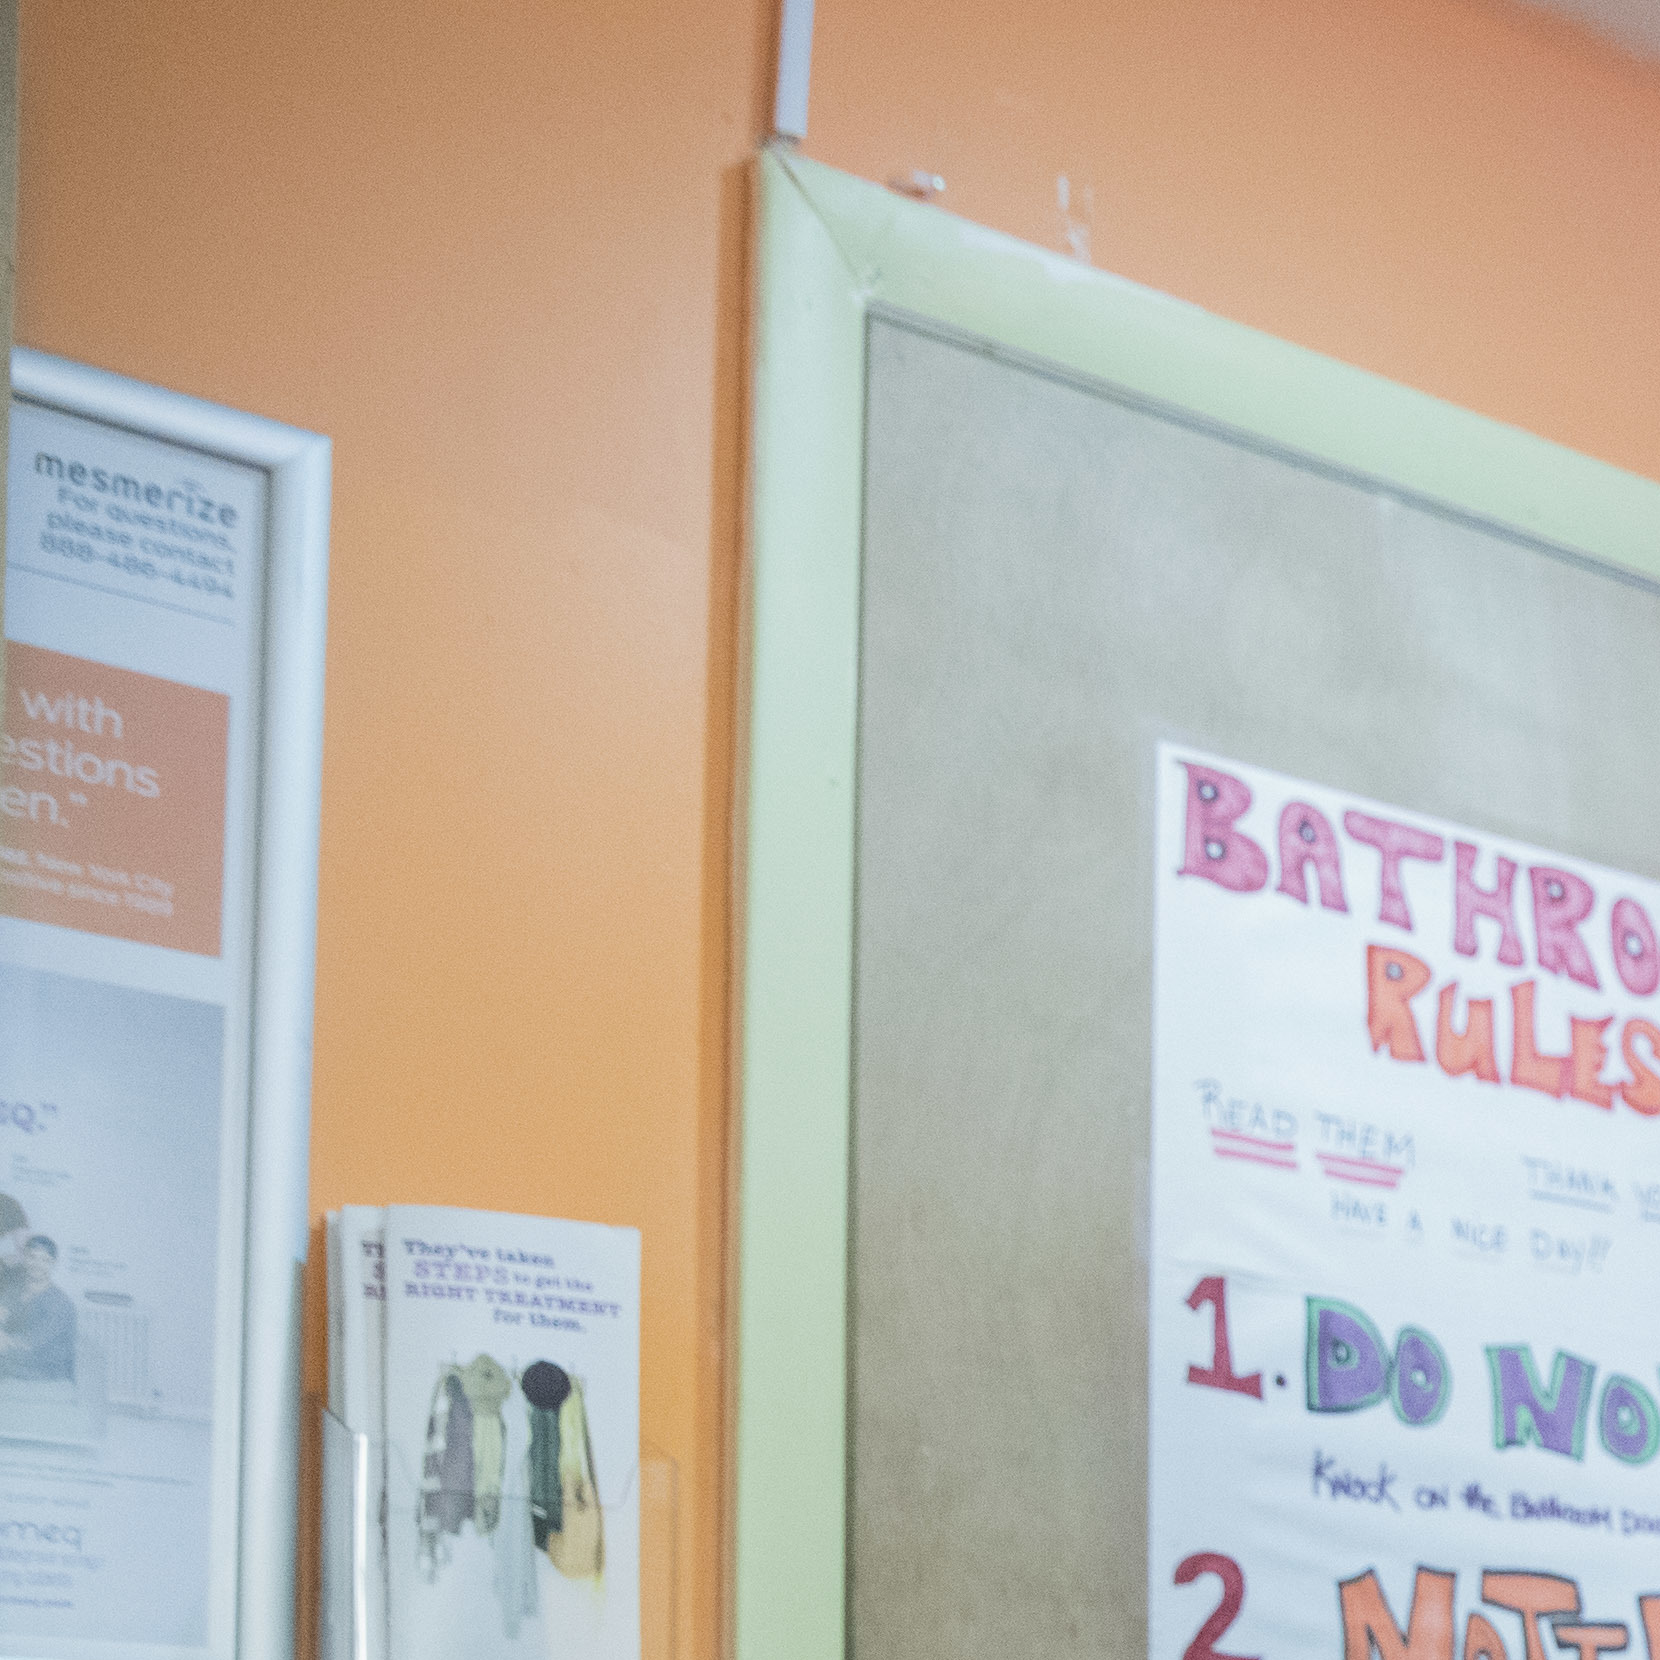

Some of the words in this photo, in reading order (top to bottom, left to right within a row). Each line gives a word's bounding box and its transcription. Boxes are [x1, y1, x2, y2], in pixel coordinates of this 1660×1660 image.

[34, 451, 239, 530] mesmerize
[20, 686, 124, 741] with
[1194, 1078, 1297, 1140] READ
[1305, 1294, 1452, 1427] DO
